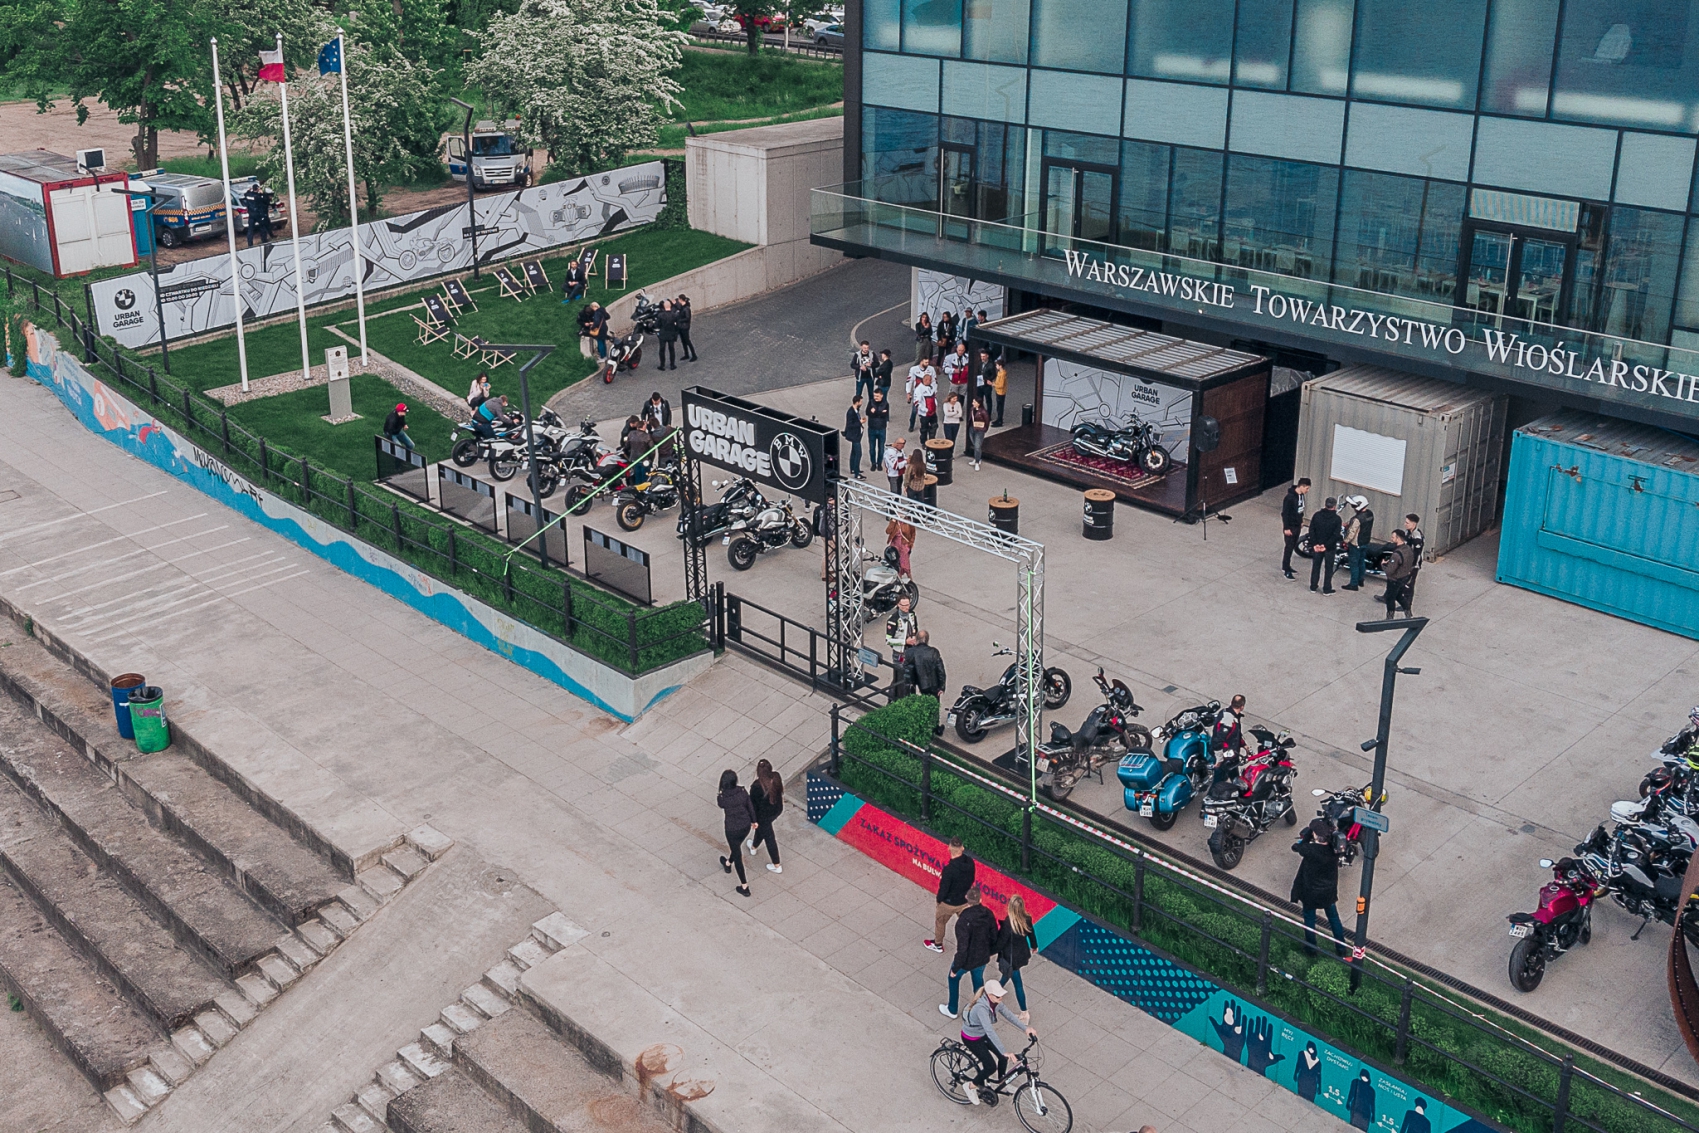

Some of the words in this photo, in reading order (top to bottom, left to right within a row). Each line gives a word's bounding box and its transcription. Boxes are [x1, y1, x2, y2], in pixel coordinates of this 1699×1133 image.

[1063, 249, 1235, 309] WARSZAWSKIE
[1250, 285, 1466, 354] TOWARZYSTWO
[114, 310, 140, 321] URBAN
[112, 317, 144, 328] GARAGE
[1134, 384, 1159, 396] URBAN
[1132, 392, 1160, 404] GARAGE
[687, 403, 755, 446] URBAN
[773, 434, 808, 459] BMW
[689, 430, 772, 478] GARAGE
[860, 818, 892, 843] ZAKAZ
[974, 879, 1011, 905] KOHO
[912, 858, 923, 869] NA
[1328, 1085, 1340, 1097] 1,5
[1393, 1090, 1407, 1101] USTA
[1382, 1114, 1394, 1126] 1,5
